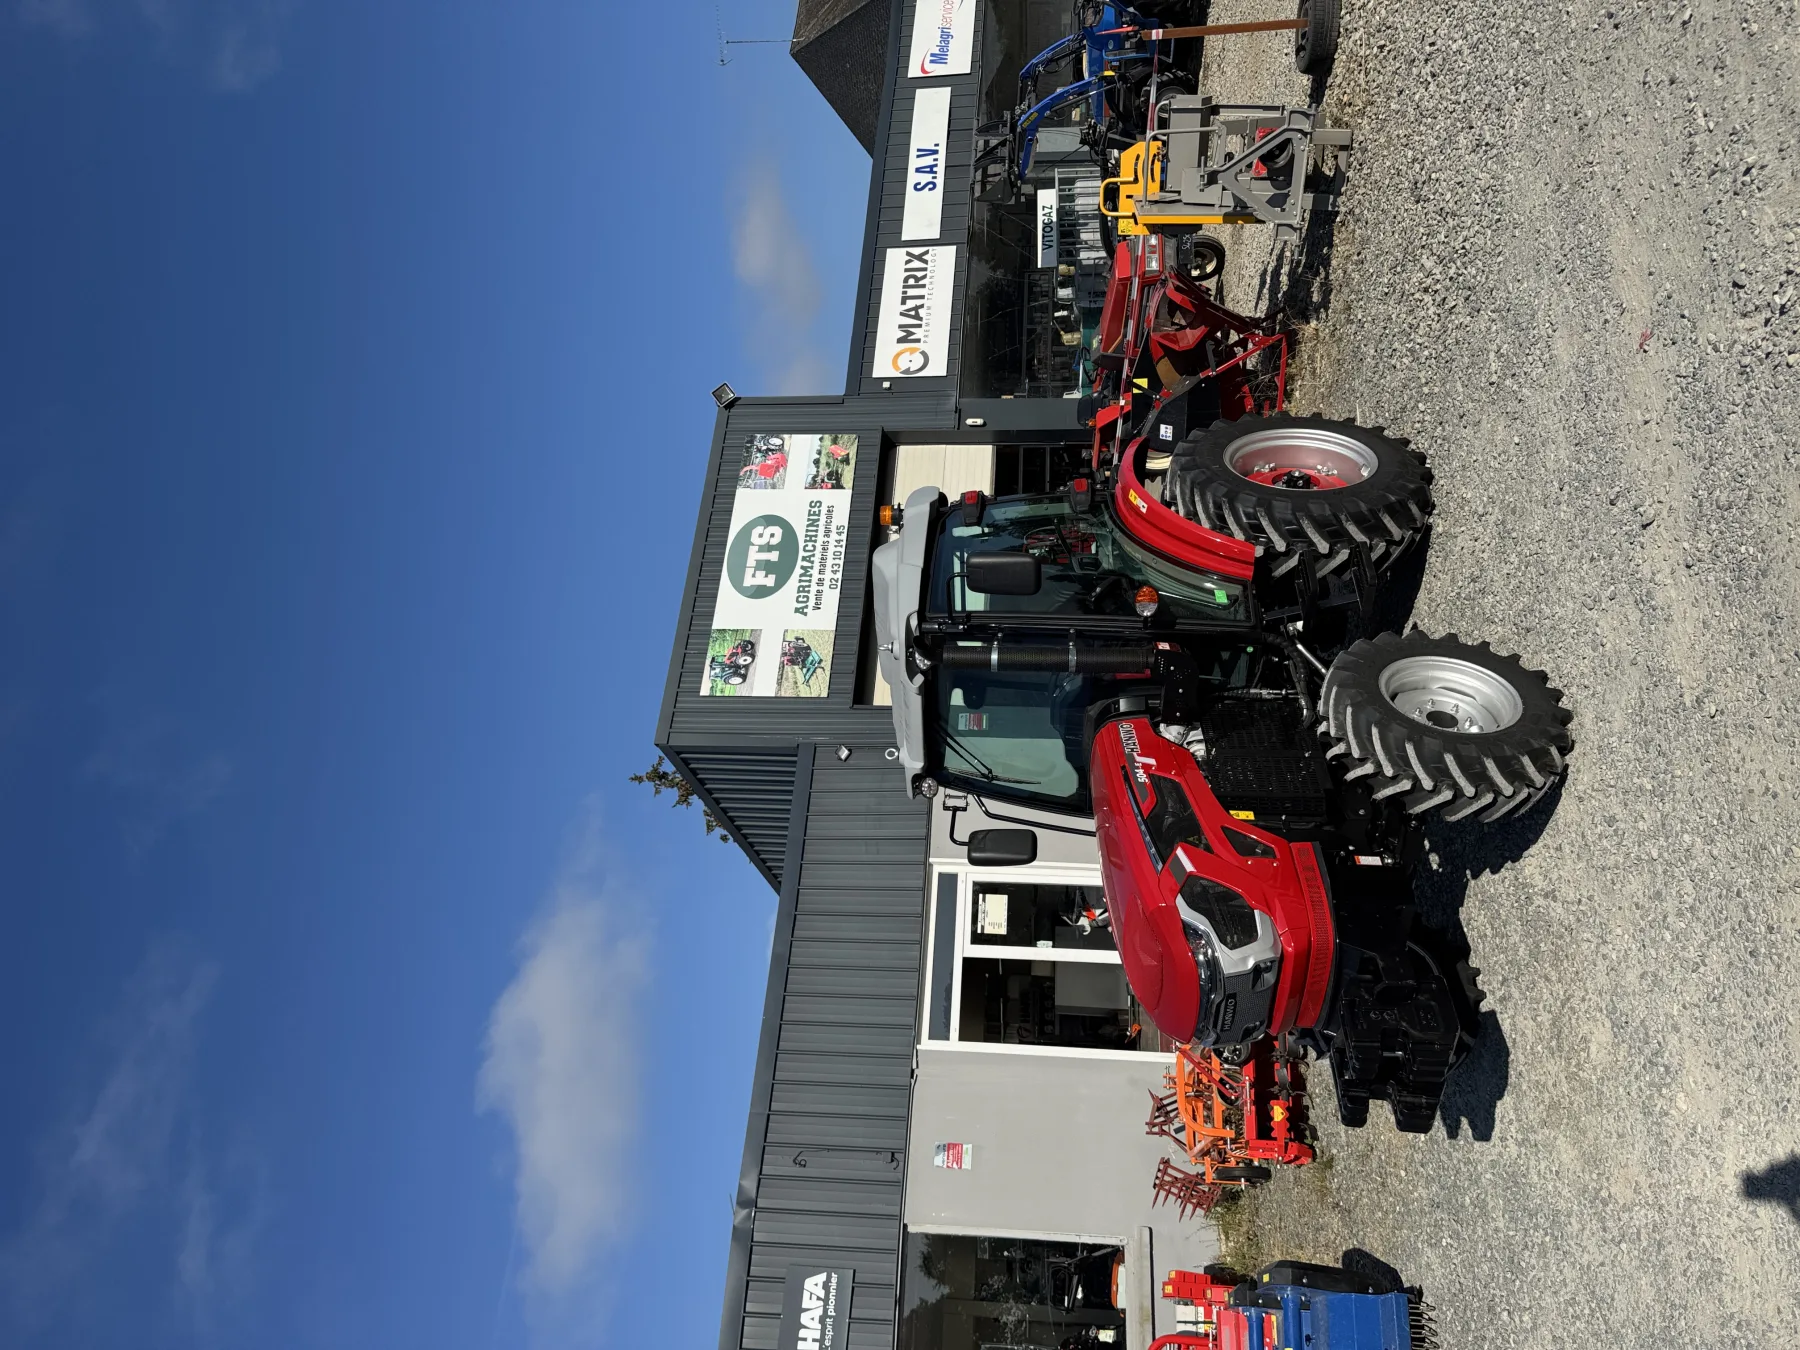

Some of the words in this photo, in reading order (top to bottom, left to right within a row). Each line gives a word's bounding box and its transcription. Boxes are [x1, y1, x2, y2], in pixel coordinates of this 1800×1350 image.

[913, 143, 939, 192] S.A.V.
[926, 248, 937, 300] TECHNOLOGY
[896, 249, 929, 344] MATRIX
[923, 305, 932, 343] PREMIUM
[823, 505, 834, 538] agricoles
[836, 525, 845, 536] 45
[743, 526, 783, 586] FTS
[794, 500, 822, 616] AGRIMACHINES
[817, 540, 830, 575] matériels
[832, 551, 842, 560] 10
[834, 539, 844, 548] 14
[816, 578, 825, 586] de
[829, 577, 839, 590] 02
[830, 563, 840, 575] 43
[812, 590, 824, 610] Vente
[1119, 723, 1141, 754] HANWO
[1223, 999, 1235, 1030] HANWO
[826, 1272, 838, 1315] pionnier
